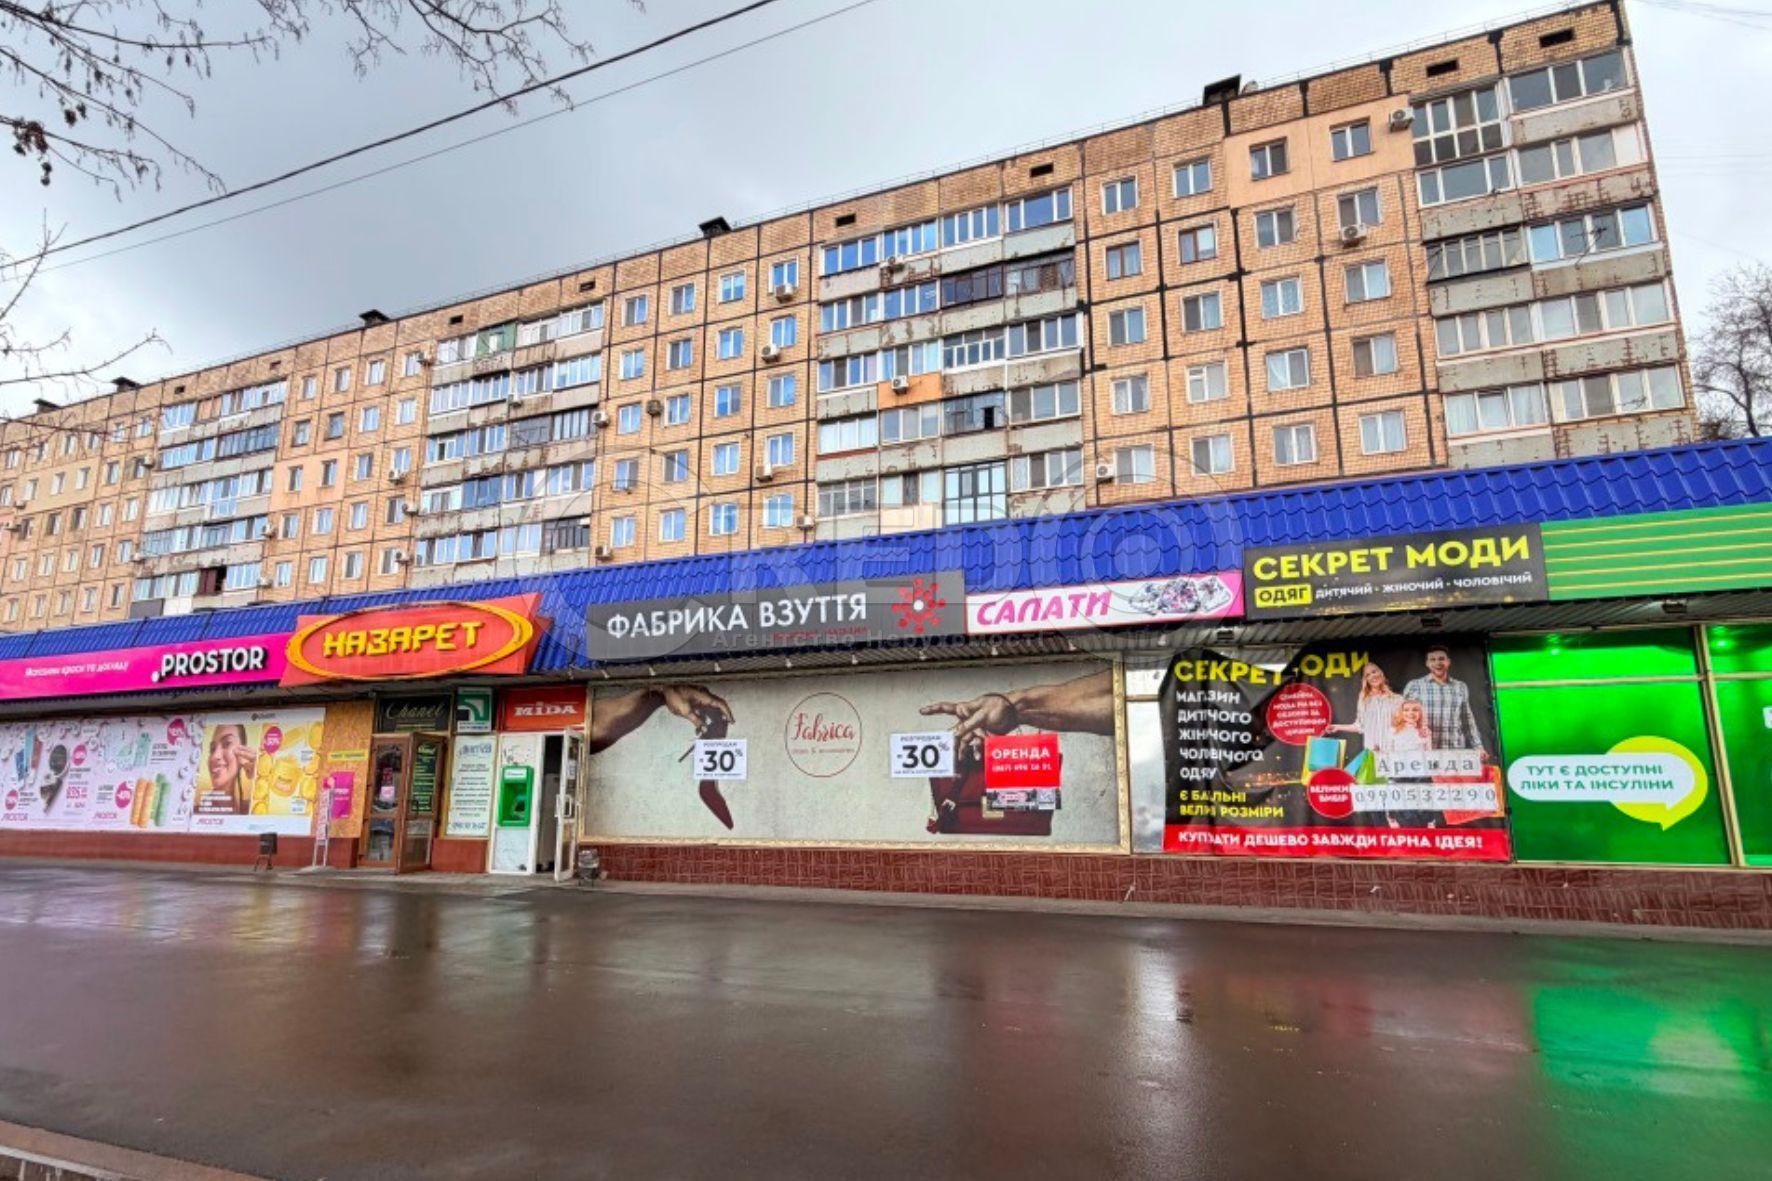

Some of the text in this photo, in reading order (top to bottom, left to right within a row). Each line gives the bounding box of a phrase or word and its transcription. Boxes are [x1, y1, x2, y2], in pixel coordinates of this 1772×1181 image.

[1253, 535, 1530, 580] СЕКРЕТ МОДИ
[1258, 587, 1308, 604] ОДЯГ
[606, 604, 749, 640] ФАБРИКА
[758, 592, 867, 628] ВЗУТТЯ
[976, 590, 1113, 626] САЛАТИ
[322, 621, 484, 657] НАЗАРЕТ
[1176, 690, 1240, 704] МАГЗИН
[791, 712, 855, 742] Fabrica
[991, 747, 1051, 760] ОРЕНДА
[1378, 758, 1474, 775] Аренда
[1527, 765, 1664, 776] ТУТ Є ДОСТУПНІ
[1520, 780, 1674, 790] ЛІКИ ТА ІНСУЛІНИ
[1220, 807, 1284, 817] РОЗМІРИ
[1244, 834, 1308, 847] ДЕШЕВО
[1312, 834, 1376, 848] ЗАВЖДИ
[1380, 834, 1430, 848] ГАРНА
[1435, 835, 1483, 849] ІДЕЯ!
